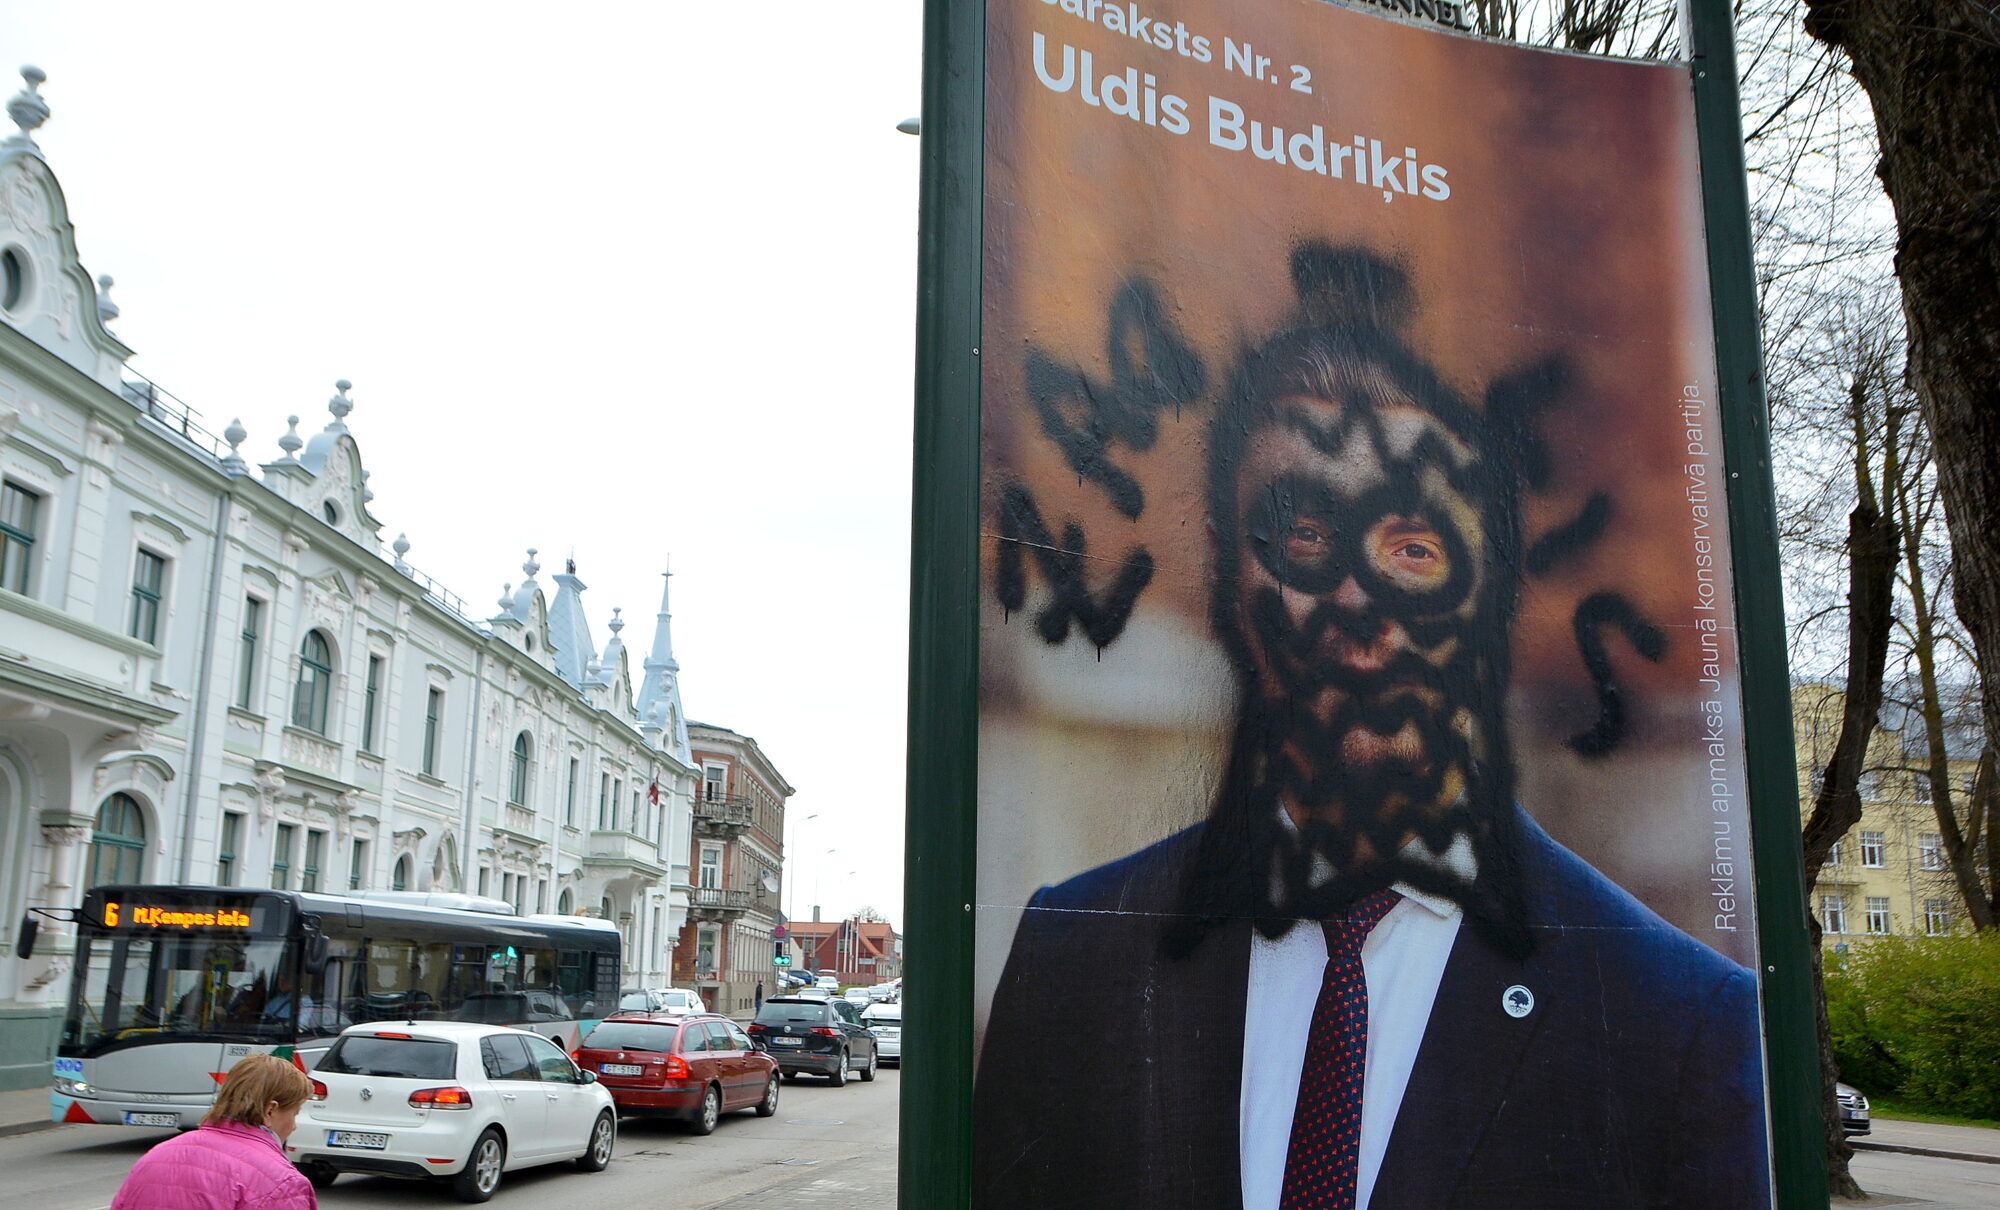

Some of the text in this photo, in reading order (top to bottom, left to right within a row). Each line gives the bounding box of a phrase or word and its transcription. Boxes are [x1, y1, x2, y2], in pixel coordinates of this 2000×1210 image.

[1040, 0, 1313, 95] araksts Nr. 2
[1032, 31, 1451, 203] Uldis Budriķis
[1678, 379, 1737, 931] Reklāmu apmaksā Jaunā konservatīvā partija.
[104, 902, 120, 927] 6
[217, 910, 250, 927] iela
[336, 1133, 385, 1147] MR-3068
